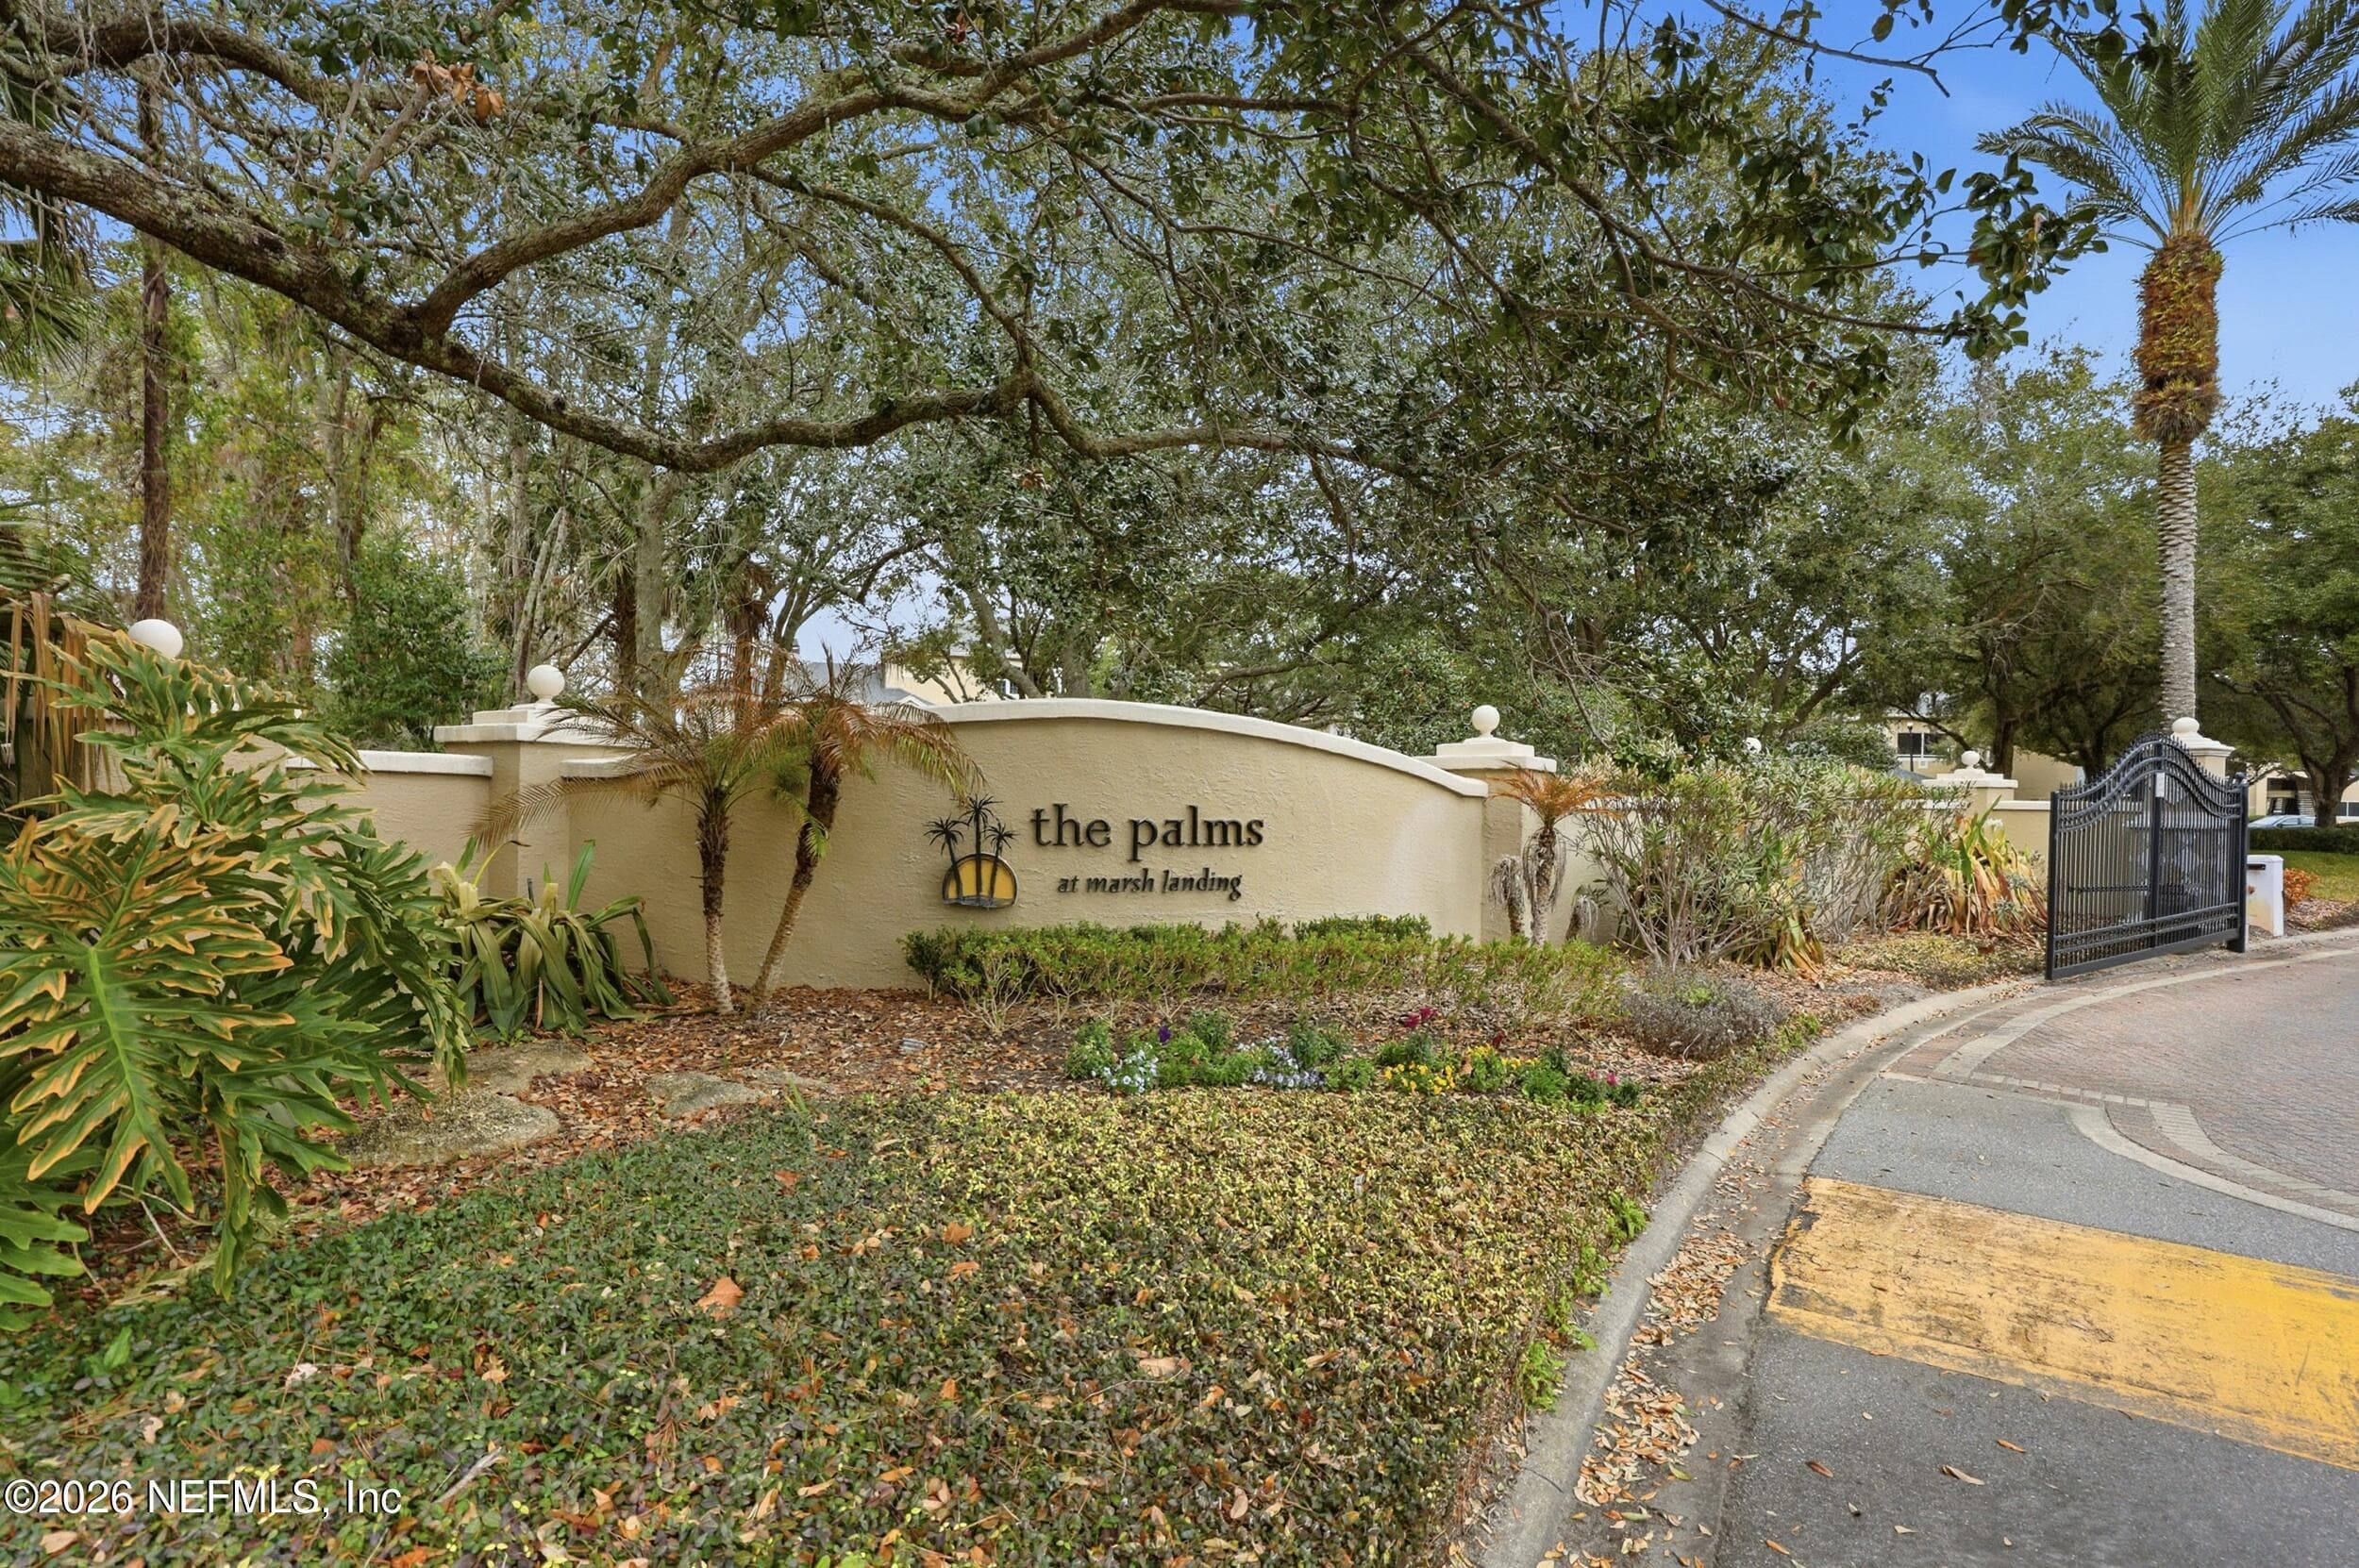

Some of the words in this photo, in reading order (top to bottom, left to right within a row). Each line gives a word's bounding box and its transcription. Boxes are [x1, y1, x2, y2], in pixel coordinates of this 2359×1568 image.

[1030, 803, 1112, 847] the
[1127, 805, 1264, 862] palms
[1057, 875, 1079, 892] at
[1086, 868, 1154, 893] marsh
[1162, 867, 1243, 901] landing
